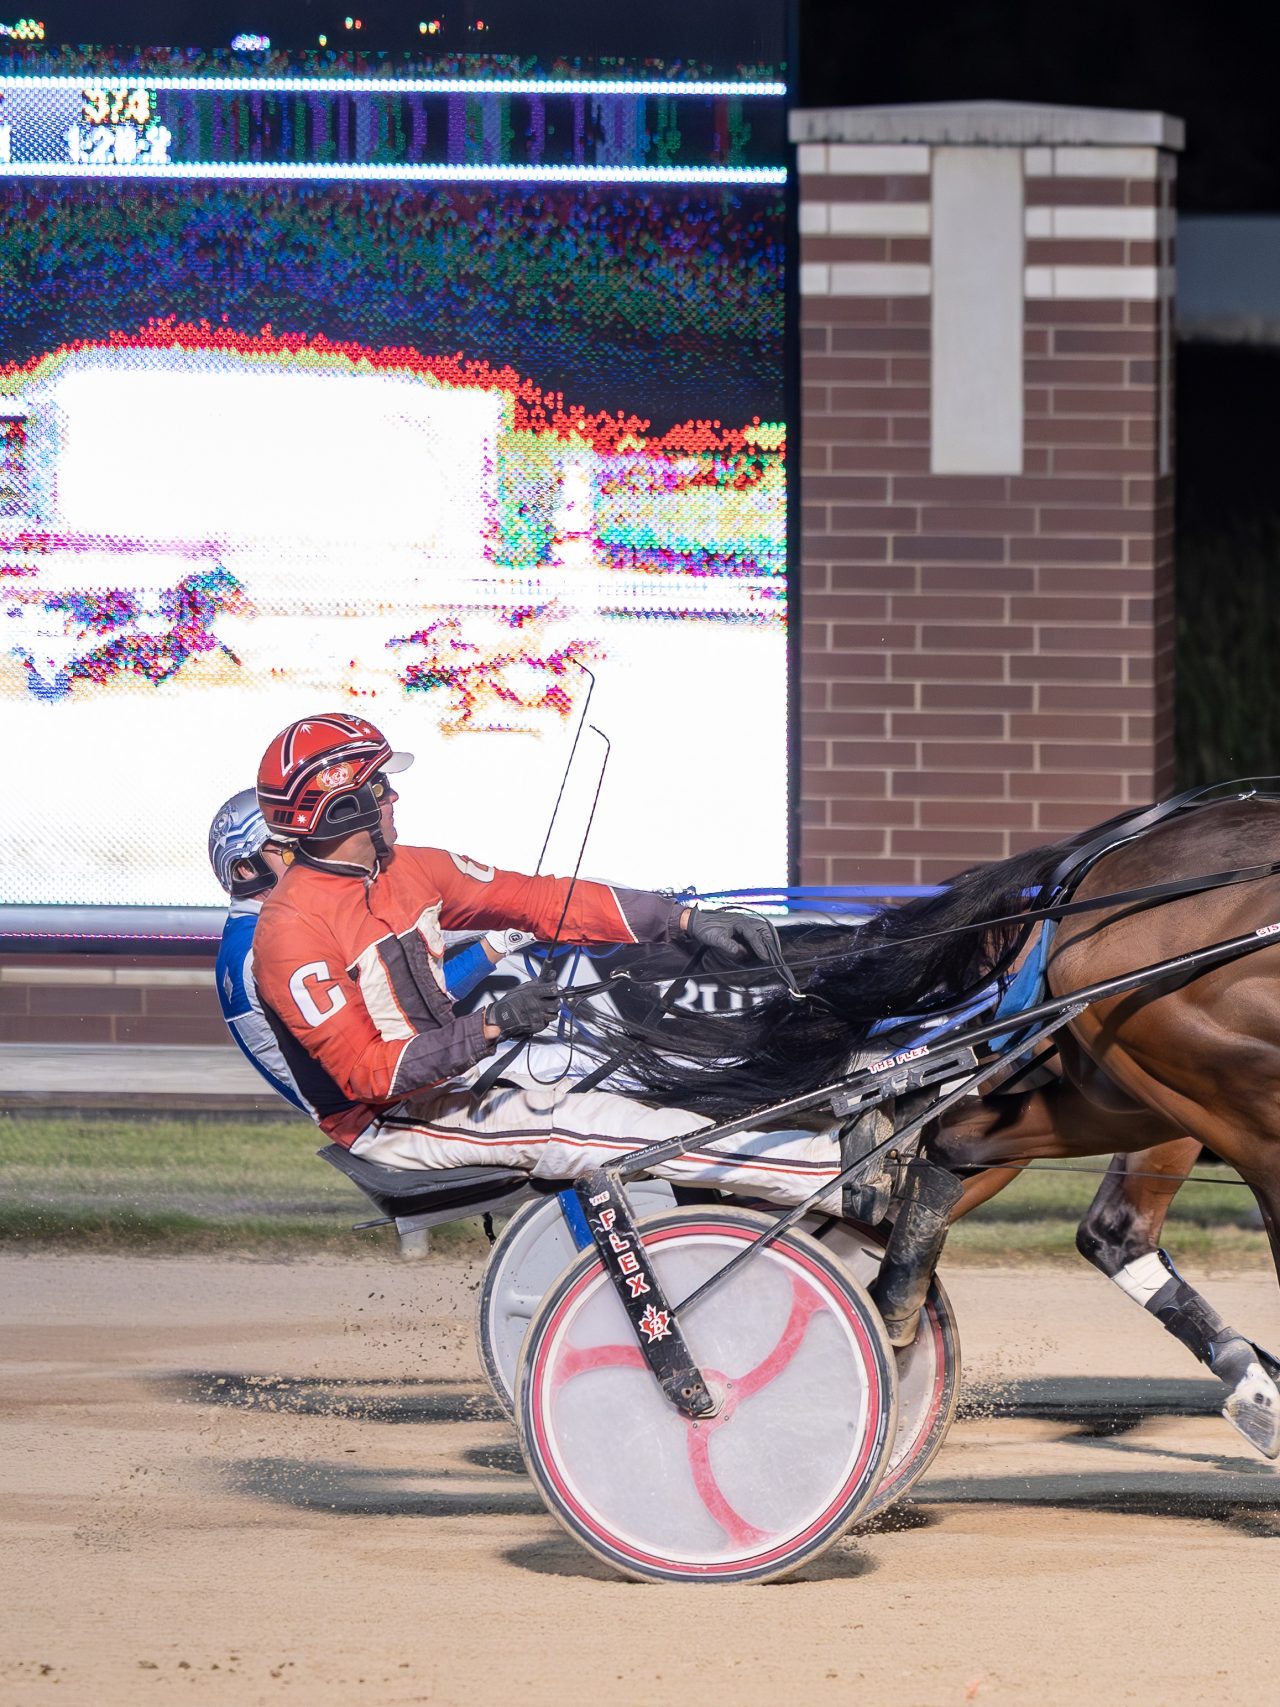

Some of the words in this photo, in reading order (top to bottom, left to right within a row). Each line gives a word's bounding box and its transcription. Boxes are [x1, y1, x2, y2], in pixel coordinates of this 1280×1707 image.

[289, 961, 347, 1028] C
[868, 1058, 895, 1075] THE
[896, 1045, 930, 1065] FLEX
[589, 1191, 610, 1206] THE
[599, 1208, 651, 1298] FLEX
